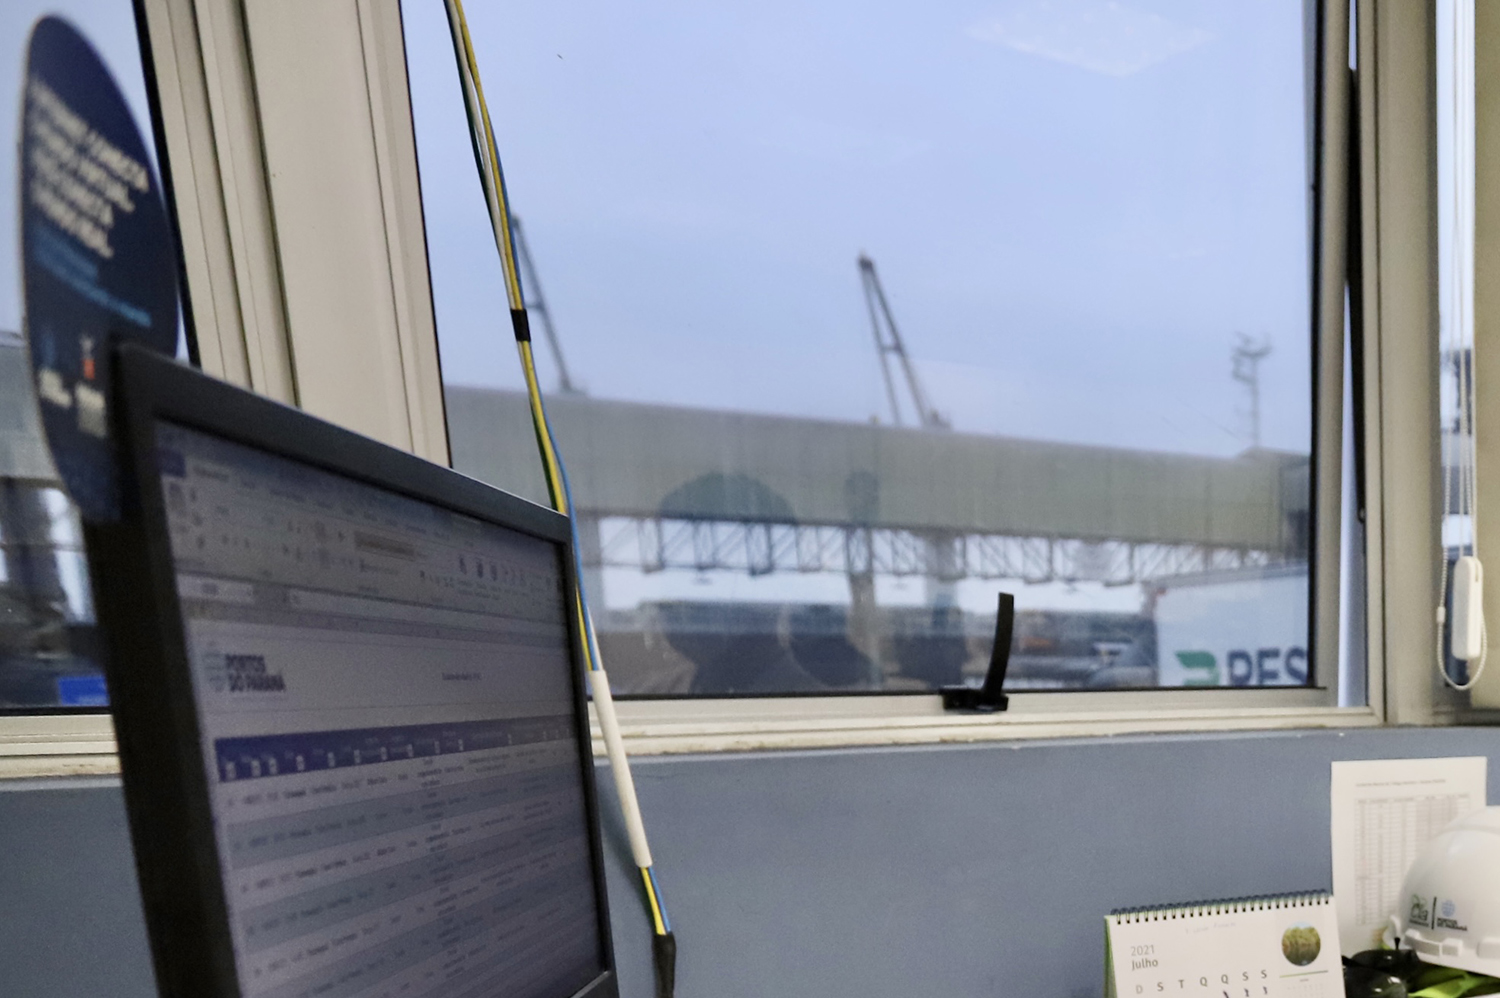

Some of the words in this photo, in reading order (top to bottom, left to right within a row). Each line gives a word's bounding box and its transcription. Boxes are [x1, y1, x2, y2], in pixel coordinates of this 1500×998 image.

[1131, 944, 1155, 957] 2021
[1131, 958, 1159, 971] Julho
[1136, 985, 1143, 994] D
[1157, 982, 1164, 992] S
[1178, 979, 1184, 989] T
[1200, 977, 1208, 987] Q
[1221, 974, 1229, 984] Q
[1242, 971, 1249, 981] S
[1261, 969, 1267, 979] S
